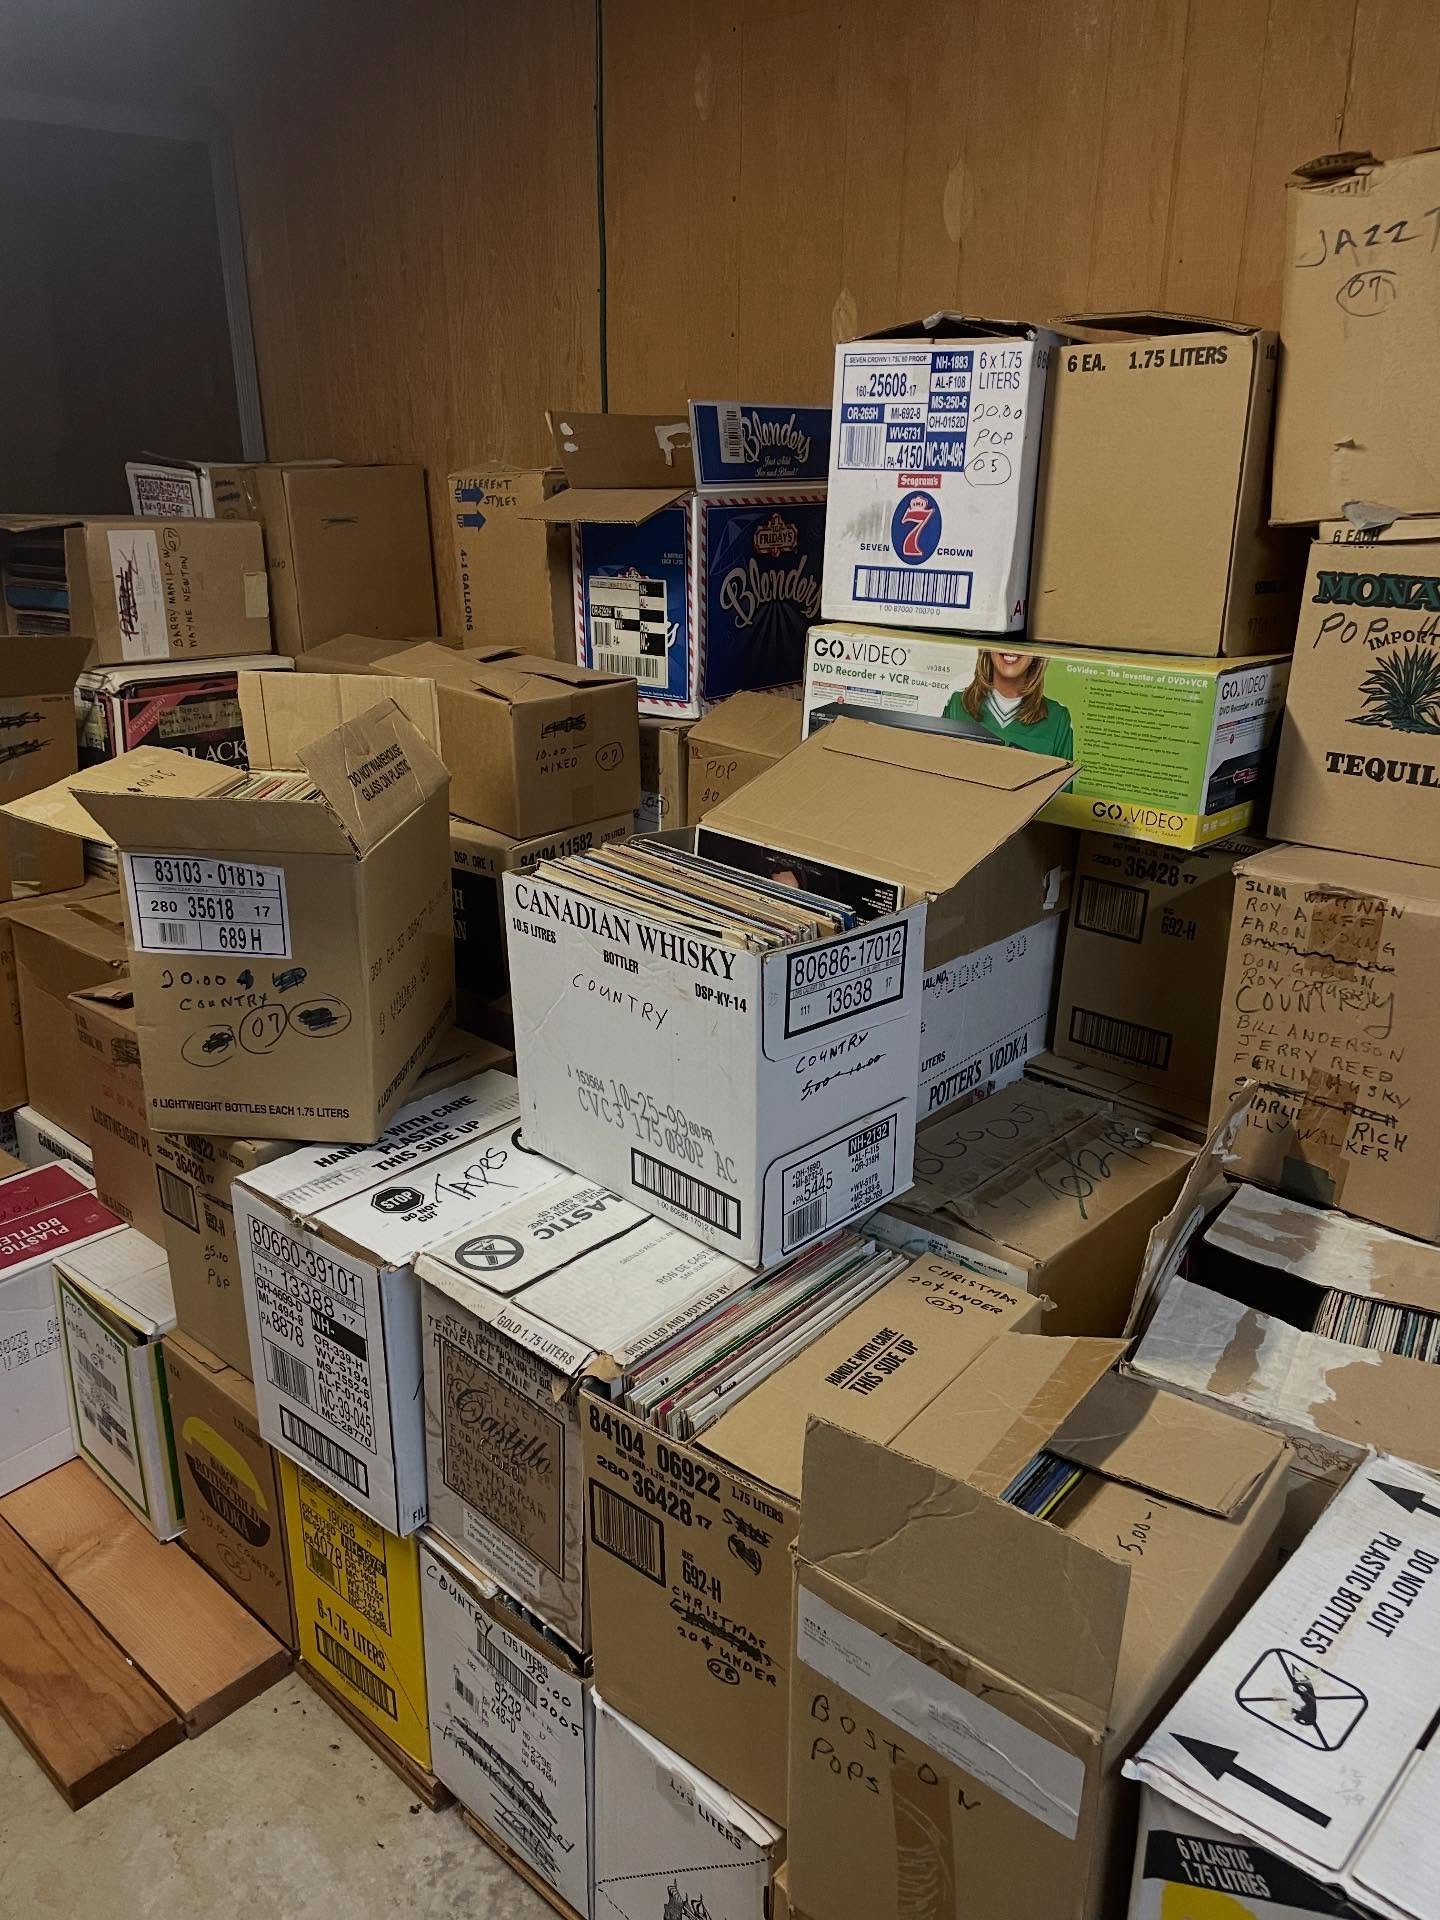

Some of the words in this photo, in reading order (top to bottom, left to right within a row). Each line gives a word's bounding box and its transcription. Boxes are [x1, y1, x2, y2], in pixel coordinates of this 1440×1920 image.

[936, 355, 969, 369] NH-1883
[979, 354, 987, 369] 6
[1000, 352, 1022, 368] 1.75
[1068, 355, 1077, 372] 6
[1082, 354, 1106, 372] EA.
[1129, 350, 1165, 369] 1.75
[1170, 346, 1228, 367] LITERS
[935, 375, 966, 389] AL-F108
[979, 372, 1020, 390] LITERS
[931, 395, 967, 409] MS-250-6
[741, 410, 812, 463] Blenders
[889, 426, 921, 440] WV-6731
[974, 428, 1013, 447] POP
[456, 479, 512, 490] DIFFERENT
[899, 473, 939, 488] Seagram's
[484, 497, 517, 508] STYLES
[758, 531, 794, 546] FRIDAY'S
[860, 543, 890, 552] SEVEN
[937, 548, 973, 557] CROWN
[902, 507, 934, 556] 7
[462, 573, 473, 631] GALLONS
[1313, 612, 1389, 648] POP
[813, 663, 833, 674] DVD
[836, 666, 876, 680] Recorder
[889, 673, 910, 685] VCR
[911, 680, 950, 690] DUAL-DECK
[1066, 665, 1098, 675] GoVideo
[1107, 669, 1119, 678] The
[1122, 671, 1153, 682] Inventor
[1157, 675, 1165, 683] of
[1168, 676, 1208, 688] DVD+VCR
[349, 771, 362, 787] DO
[359, 762, 374, 780] NOT
[371, 743, 404, 773] WAREHOUSE
[361, 779, 385, 802] GLASS
[383, 774, 394, 790] ON
[389, 758, 412, 785] PLASTIC
[541, 757, 578, 775] MIXED
[705, 760, 737, 781] POP
[1325, 752, 1440, 789] TEQUIL
[154, 860, 201, 883] 83103
[1124, 855, 1181, 888] 36428
[151, 900, 178, 912] 280
[187, 896, 234, 920] 35618
[254, 906, 270, 917] 17
[1245, 898, 1282, 918] ROY
[512, 917, 530, 934] 10.5
[530, 925, 557, 945] LITRES
[515, 883, 631, 946] CANADIAN
[635, 922, 737, 982] WHISKY
[1160, 915, 1198, 942] 692-H
[603, 949, 640, 975] BOTTLER
[794, 930, 901, 987] 80686-17012
[1242, 953, 1280, 973] DON
[827, 977, 873, 1016] 13638
[1240, 967, 1284, 989] ROY
[179, 992, 268, 1011] COUNTRY
[572, 972, 670, 1031] COUNTRY
[694, 983, 748, 1014] DSP-KY-14
[795, 1032, 869, 1074] COUNTRY
[1236, 1015, 1279, 1036] BILL
[1288, 1023, 1406, 1064] ANDERSON
[1238, 1034, 1317, 1065] JERRY
[1331, 1056, 1394, 1082] REED
[921, 1051, 947, 1073] LITERS
[927, 1059, 983, 1112] POTTER'S
[988, 1032, 1029, 1075] VODKA
[160, 1098, 223, 1113] LIGHTWEIGHT
[225, 1101, 267, 1115] BOTTLES
[269, 1105, 294, 1116] EACH
[296, 1106, 315, 1118] 1.75
[317, 1108, 350, 1119] LITERS
[383, 1113, 433, 1144] WITH
[430, 1095, 478, 1119] CARE
[371, 1150, 419, 1172] THIS
[414, 1132, 460, 1153] SIDE
[453, 1120, 481, 1141] UP
[377, 1121, 450, 1156] PLASTIC
[850, 1122, 890, 1156] NH-2132
[1351, 1122, 1409, 1152] RICH
[714, 1150, 738, 1185] AC
[804, 1171, 833, 1201] 5445
[380, 1188, 413, 1211] STOP
[400, 1211, 419, 1223] DO
[416, 1202, 440, 1216] NOT
[417, 1210, 439, 1223] CUT
[2, 1223, 71, 1256] PLASTIC
[252, 1219, 357, 1302] 80660-39101
[281, 1271, 335, 1319] 13388
[907, 1276, 932, 1287] 20
[948, 1289, 1004, 1315] UNDER
[927, 1264, 1019, 1307] CHRISTMAS
[271, 1310, 305, 1348] 8878
[311, 1308, 336, 1336] NH-
[623, 1326, 669, 1357] DISTILLED
[665, 1315, 687, 1331] AND
[682, 1291, 720, 1320] BOTTLED
[716, 1284, 732, 1296] BY
[521, 1328, 543, 1346] 1.75
[540, 1340, 575, 1366] LITERS
[824, 1354, 862, 1387] HANDLE
[853, 1340, 878, 1368] WITH
[872, 1327, 899, 1351] CARE
[315, 1345, 369, 1387] WV-5194
[847, 1370, 885, 1396] THIS
[875, 1350, 907, 1376] SIDE
[898, 1338, 919, 1359] UP
[318, 1371, 369, 1412] AL-F-0144
[319, 1382, 373, 1438] NC-39-045
[589, 1403, 646, 1460] 84104
[656, 1443, 722, 1504] 06922
[596, 1454, 630, 1482] 280
[631, 1468, 693, 1527] 36428
[695, 1513, 714, 1531] 17
[731, 1485, 751, 1506] 1.75
[753, 1496, 785, 1525] LITERS
[208, 1485, 250, 1540] VODKA
[1345, 1531, 1402, 1592] PLASTIC
[1406, 1548, 1440, 1575] DO
[682, 1559, 723, 1604] 692-H
[1387, 1569, 1426, 1608] NOT
[426, 1565, 494, 1638] COUNTRY
[1366, 1601, 1405, 1638] CUT
[1299, 1586, 1364, 1655] BOTTLES
[352, 1628, 387, 1672] LITERS
[502, 1631, 519, 1653] 1.75
[520, 1644, 549, 1680] LITERS
[676, 1625, 699, 1644] 20
[719, 1646, 777, 1688] UNDER
[494, 1681, 523, 1723] 9238
[811, 1694, 982, 1811] BOSTON
[697, 1803, 743, 1851] LITERS
[1177, 1836, 1190, 1858] 6
[1192, 1841, 1256, 1874] PLASTIC
[1179, 1859, 1211, 1884] 1.75
[1212, 1866, 1271, 1899] LITRES
